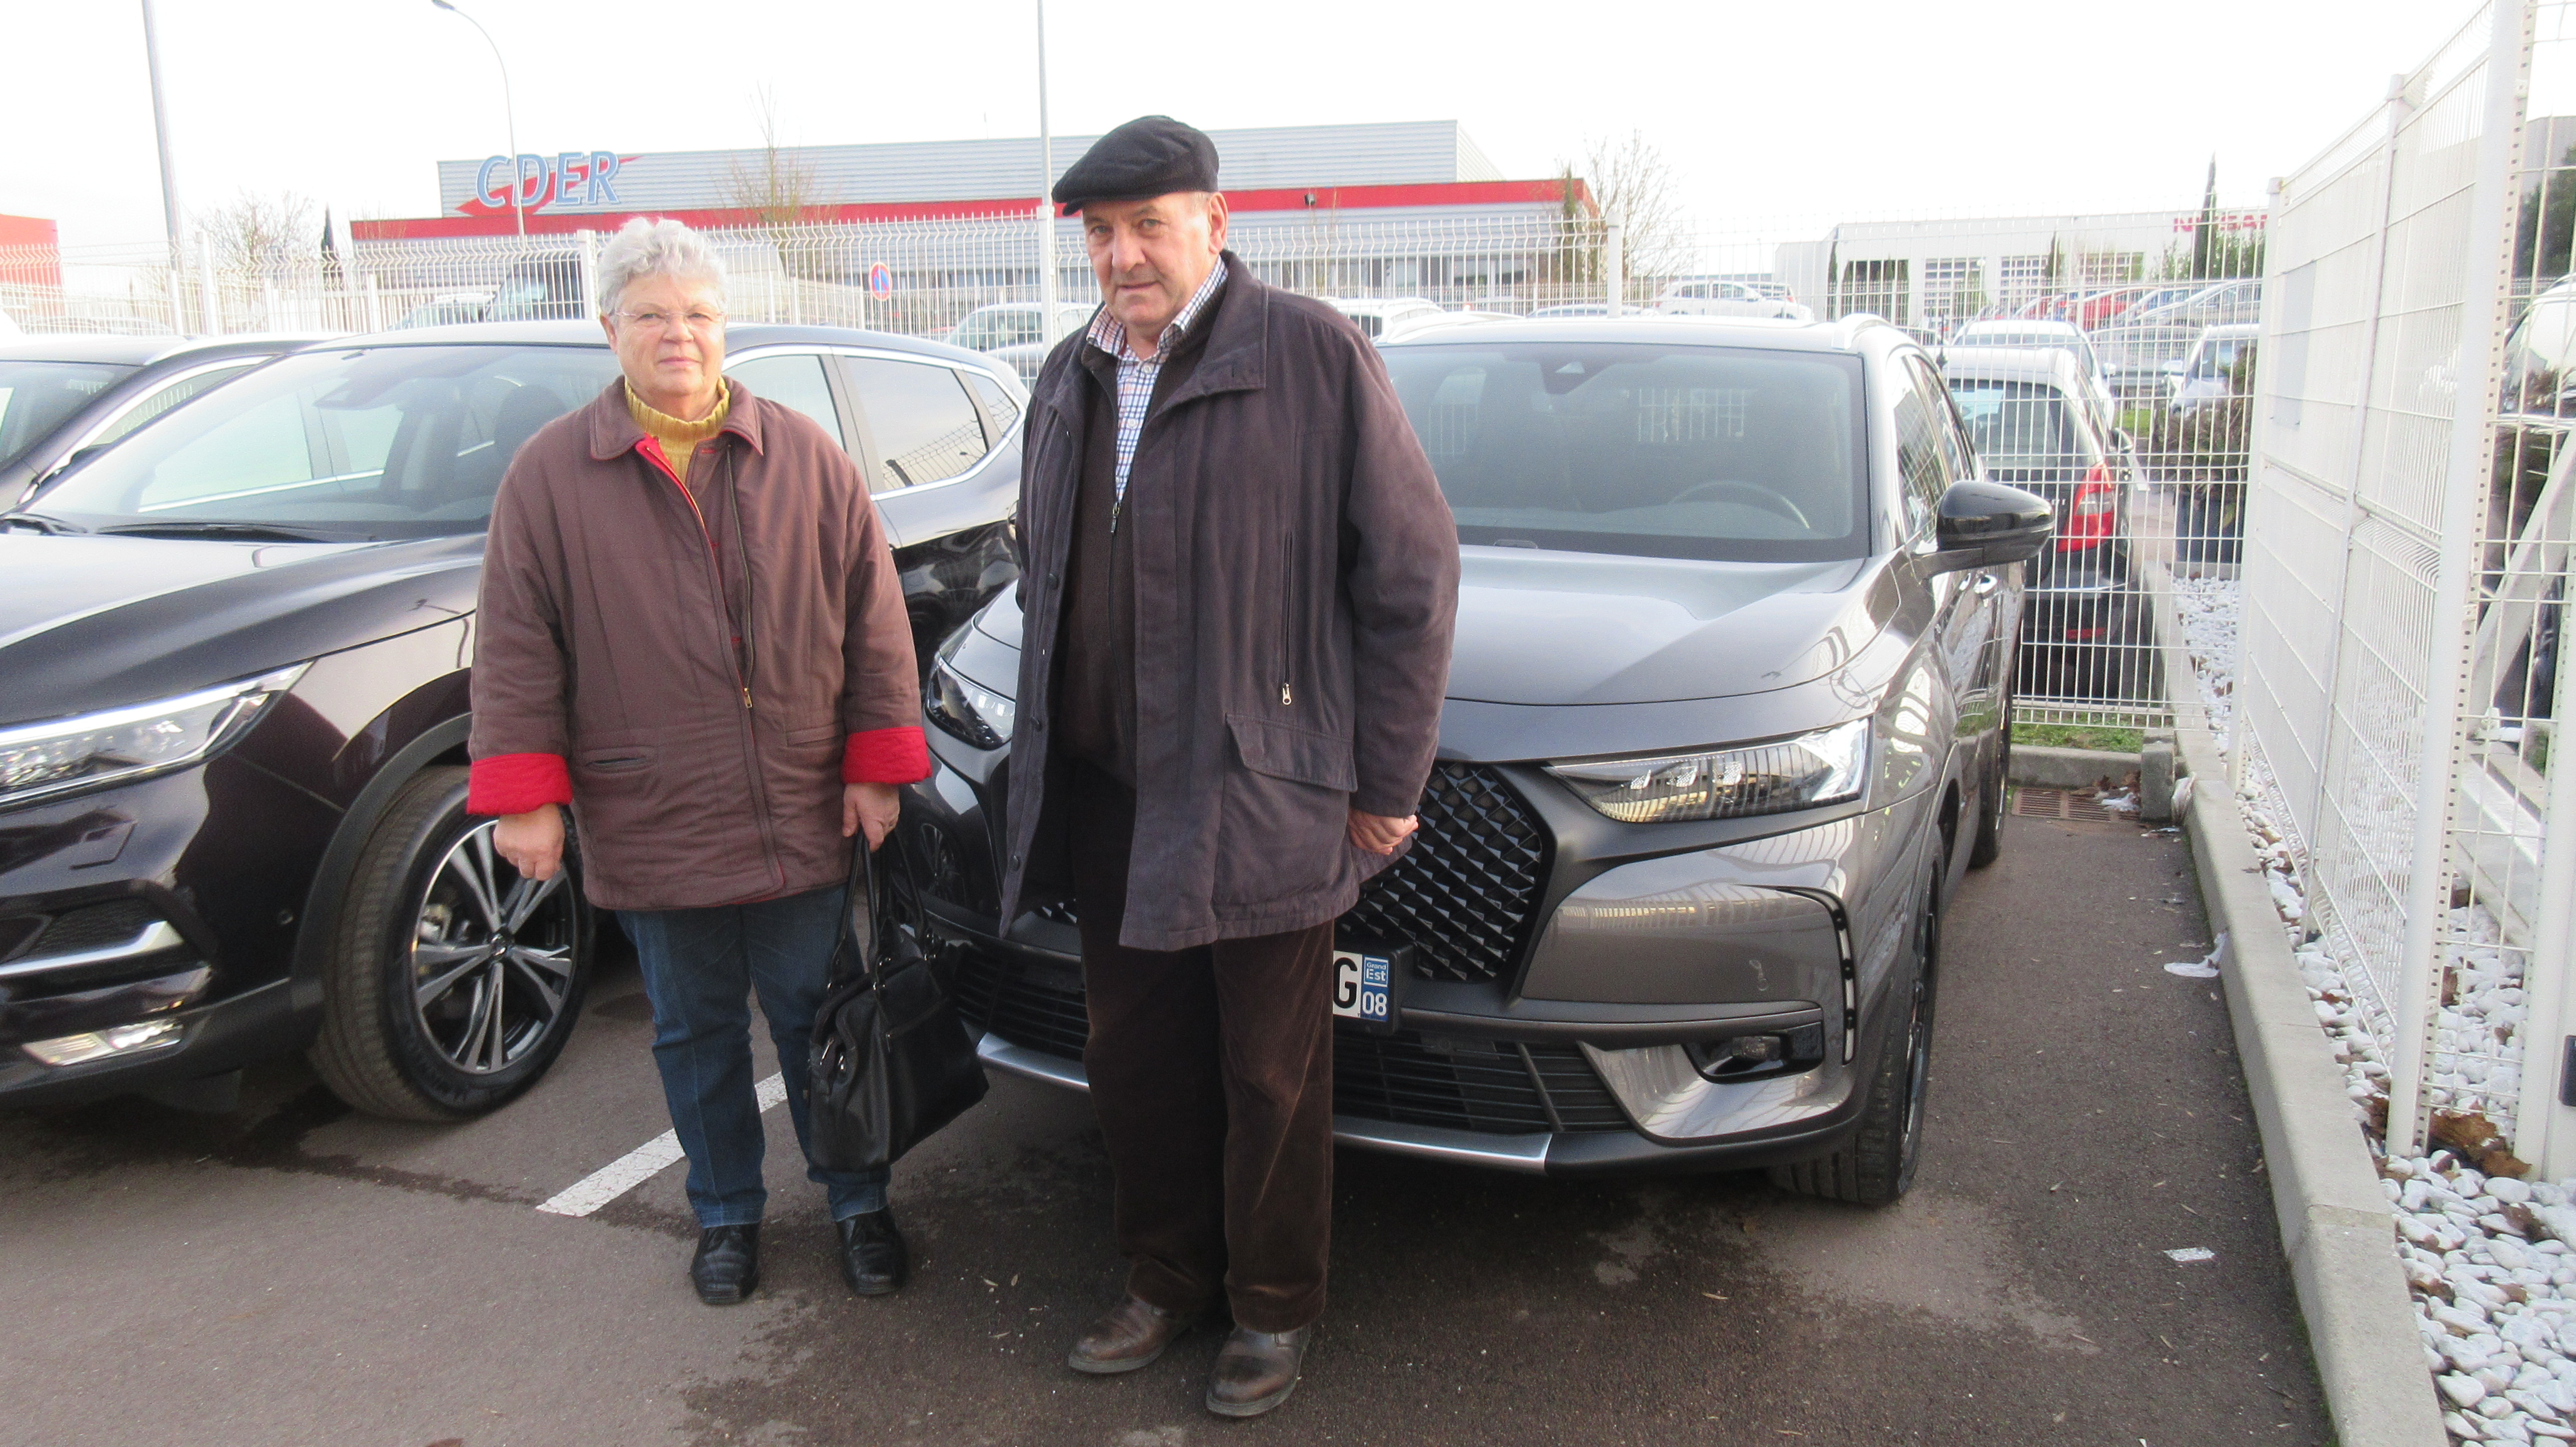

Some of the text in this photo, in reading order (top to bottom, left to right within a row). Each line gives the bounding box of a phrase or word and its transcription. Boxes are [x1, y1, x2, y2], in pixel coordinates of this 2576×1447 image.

[475, 151, 621, 207] CDER
[1367, 968, 1386, 981] Est
[1363, 991, 1387, 1016] 08
